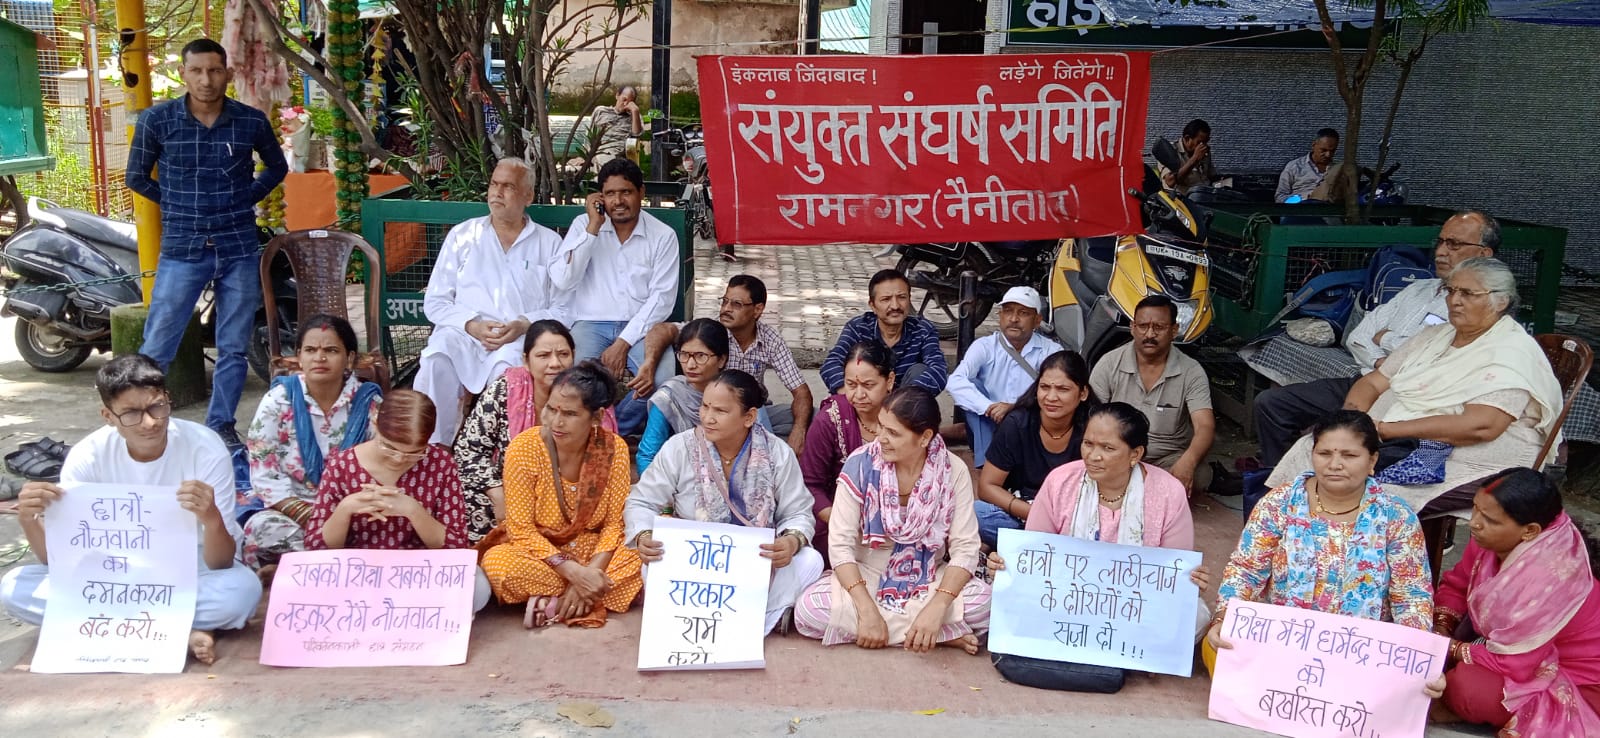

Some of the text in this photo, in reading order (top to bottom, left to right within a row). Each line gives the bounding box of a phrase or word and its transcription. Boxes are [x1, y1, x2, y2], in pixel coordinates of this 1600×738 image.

[730, 63, 792, 84] इंकलाब
[795, 63, 867, 84] जिंदाबाद
[999, 59, 1044, 83] लड़ेंगे
[737, 82, 1122, 185] संयुक्त संघर्ष समिति
[777, 194, 931, 229] रामनगर
[102, 556, 128, 573] का
[685, 534, 737, 573] मोदी
[1017, 543, 1183, 594] छात्रों पर लाठीचार्ज
[345, 557, 384, 588] शिक्षा
[387, 560, 432, 589] सबको
[435, 564, 468, 588] काम
[668, 579, 737, 612] सरकार
[1040, 580, 1057, 612] के
[1120, 591, 1148, 624] को
[79, 613, 114, 638] बंद
[274, 602, 338, 633] लड़कर
[674, 611, 722, 644] शर्म
[1096, 621, 1118, 651] दो
[1230, 606, 1277, 643] शिक्षा
[1277, 618, 1316, 651] मंत्री
[1376, 640, 1437, 679] प्रधान
[1296, 657, 1325, 687] को
[1259, 686, 1334, 727] बर्खास्त
